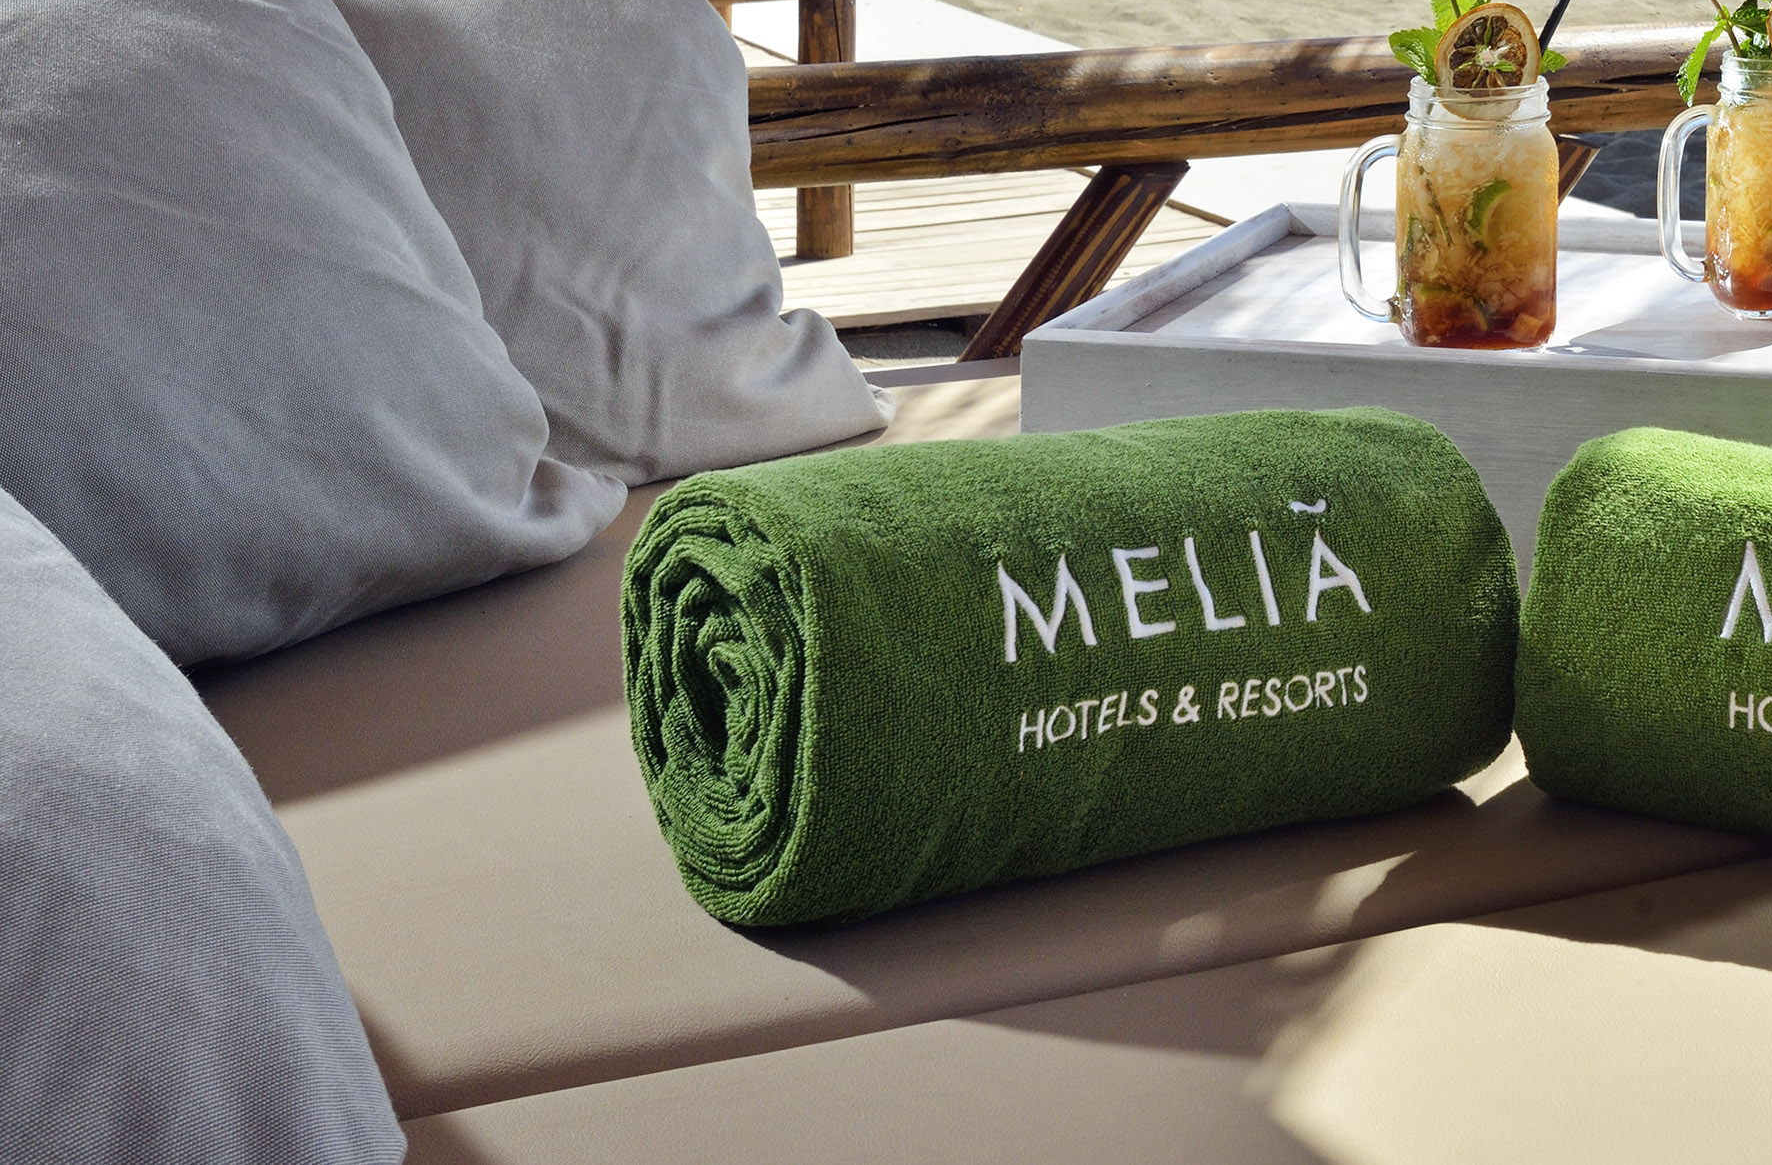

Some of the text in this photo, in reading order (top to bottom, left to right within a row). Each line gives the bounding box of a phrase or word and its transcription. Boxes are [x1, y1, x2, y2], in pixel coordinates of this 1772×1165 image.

[1018, 665, 1369, 752] HOTELS & RESORTS
